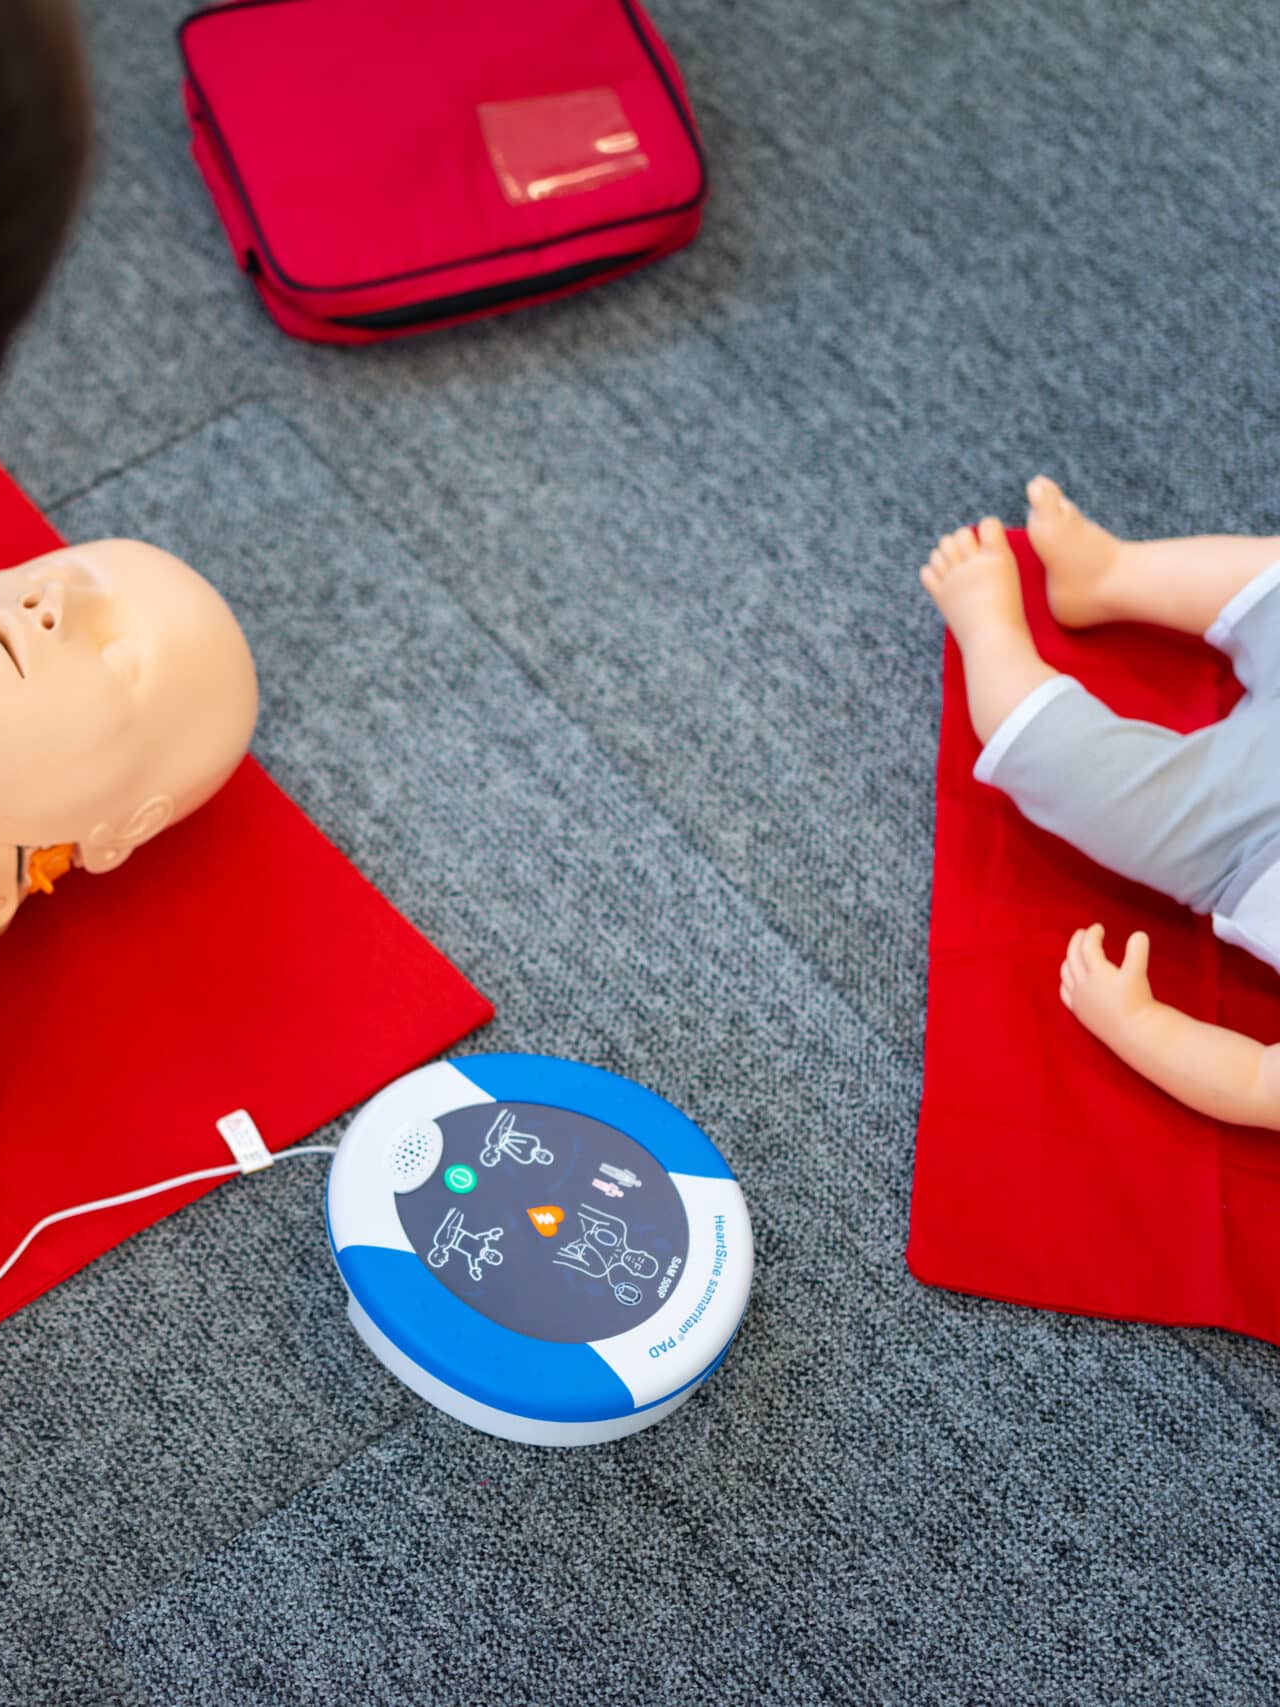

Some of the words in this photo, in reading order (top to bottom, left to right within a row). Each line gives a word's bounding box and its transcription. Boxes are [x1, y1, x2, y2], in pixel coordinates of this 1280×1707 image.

[714, 1215, 728, 1276] HeartSine
[666, 1255, 682, 1277] SAM
[649, 1336, 677, 1359] PAD
